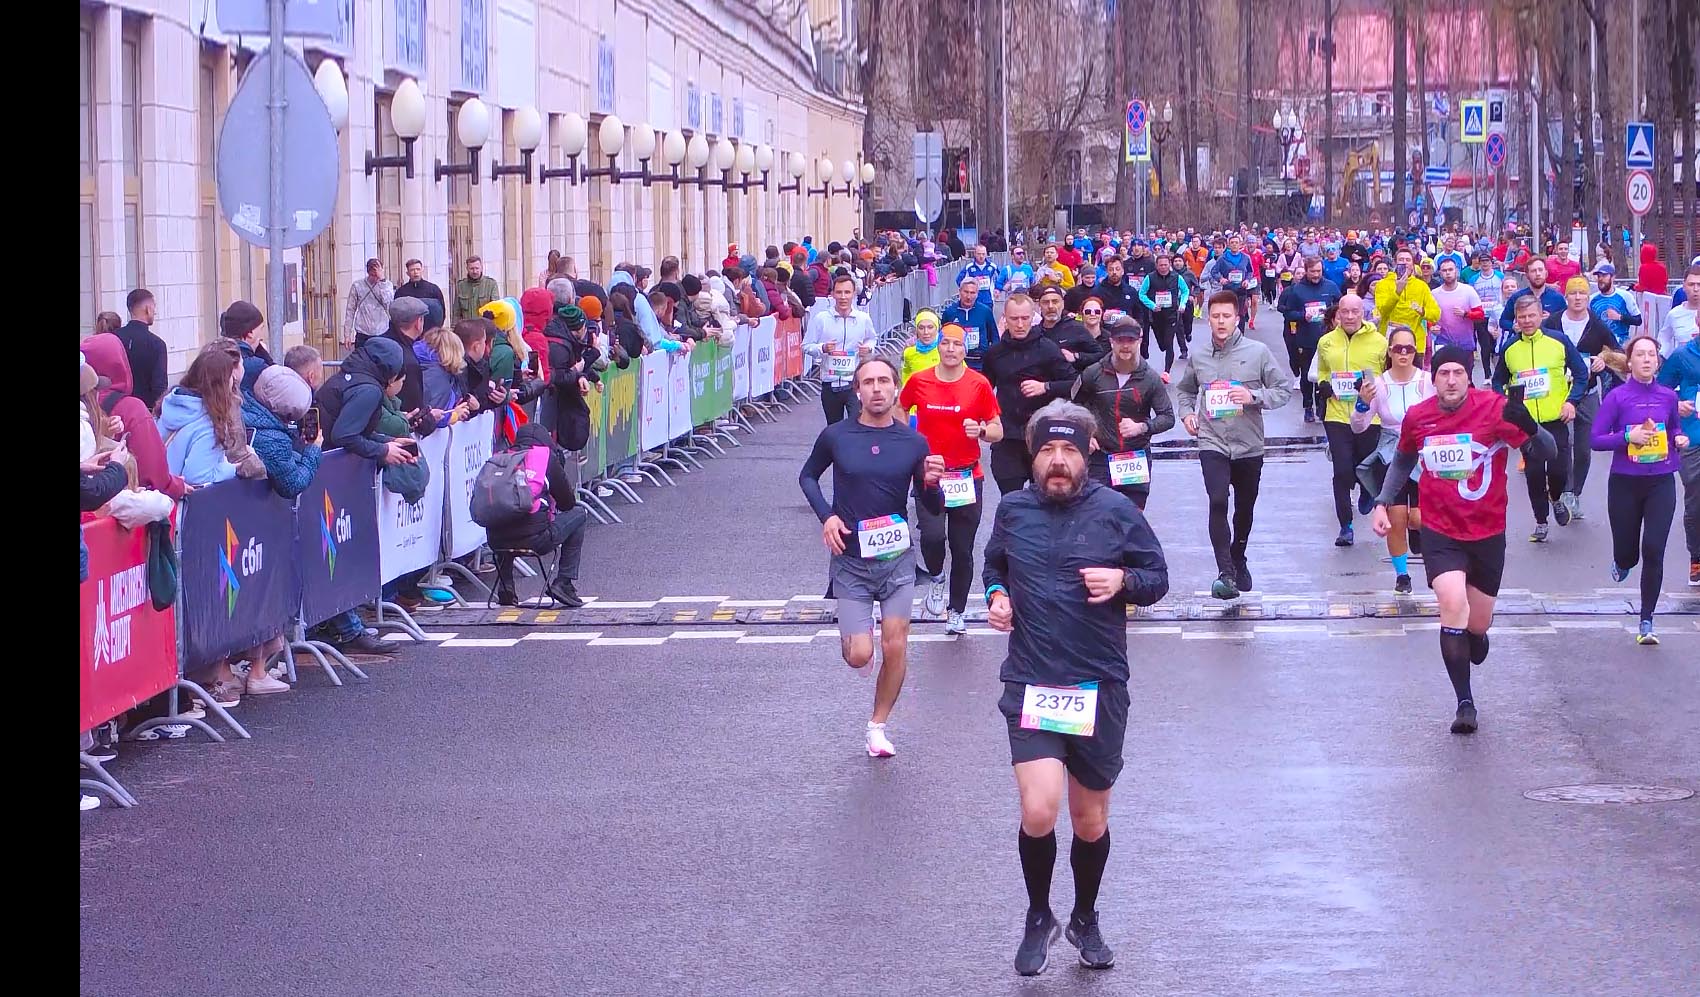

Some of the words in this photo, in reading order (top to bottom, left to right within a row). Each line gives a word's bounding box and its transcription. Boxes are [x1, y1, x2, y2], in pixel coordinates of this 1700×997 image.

[1633, 183, 1648, 201] 20
[832, 358, 851, 367] 3907
[1337, 381, 1355, 391] 190
[1210, 394, 1231, 405] 637
[1431, 448, 1465, 463] 1802
[1115, 461, 1143, 473] 5786
[336, 508, 352, 544] сбп
[867, 529, 903, 547] 4328
[241, 536, 263, 577] сбп
[110, 563, 148, 617] МОСКОВСК
[110, 614, 132, 664] СПОРТ
[1035, 693, 1086, 712] 2375
